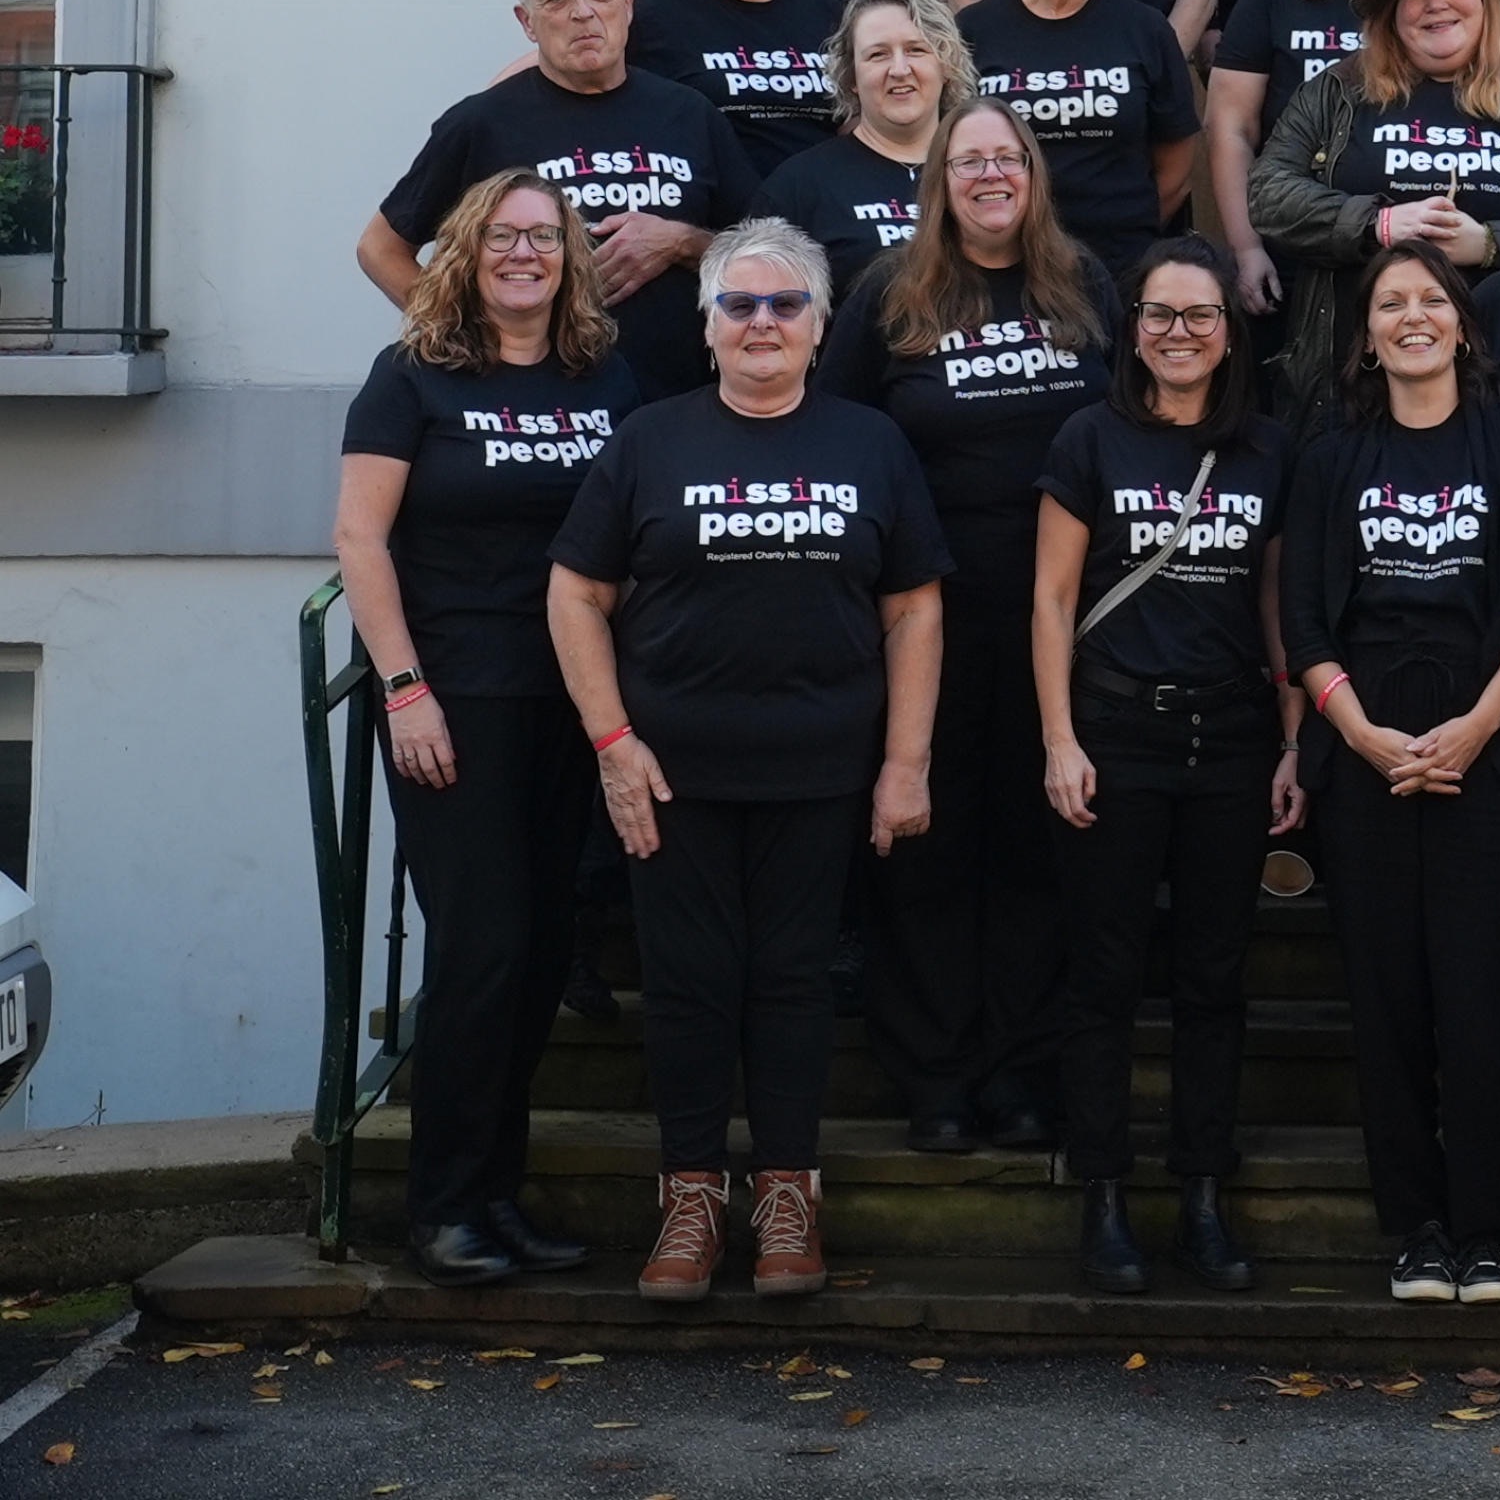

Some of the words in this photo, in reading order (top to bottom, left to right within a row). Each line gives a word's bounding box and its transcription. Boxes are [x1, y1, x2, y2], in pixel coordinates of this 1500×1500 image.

[702, 45, 829, 71] missin
[978, 65, 1130, 96] missing
[1010, 89, 1119, 126] eople
[536, 145, 693, 182] missing
[1389, 180, 1432, 192] Registered
[1462, 182, 1478, 191] No.
[945, 340, 1080, 387] people
[955, 389, 1000, 400] Registered
[1000, 385, 1030, 396] Charity
[1031, 384, 1047, 393] No.
[1049, 380, 1085, 391] 1020419
[463, 406, 613, 436] missing
[485, 435, 606, 468] people
[684, 477, 858, 514] missing
[698, 505, 846, 546] people
[1359, 510, 1480, 555] people
[706, 551, 753, 563] Registered
[754, 550, 786, 562] Charity
[787, 550, 803, 560] No.
[805, 551, 841, 562] 1020419
